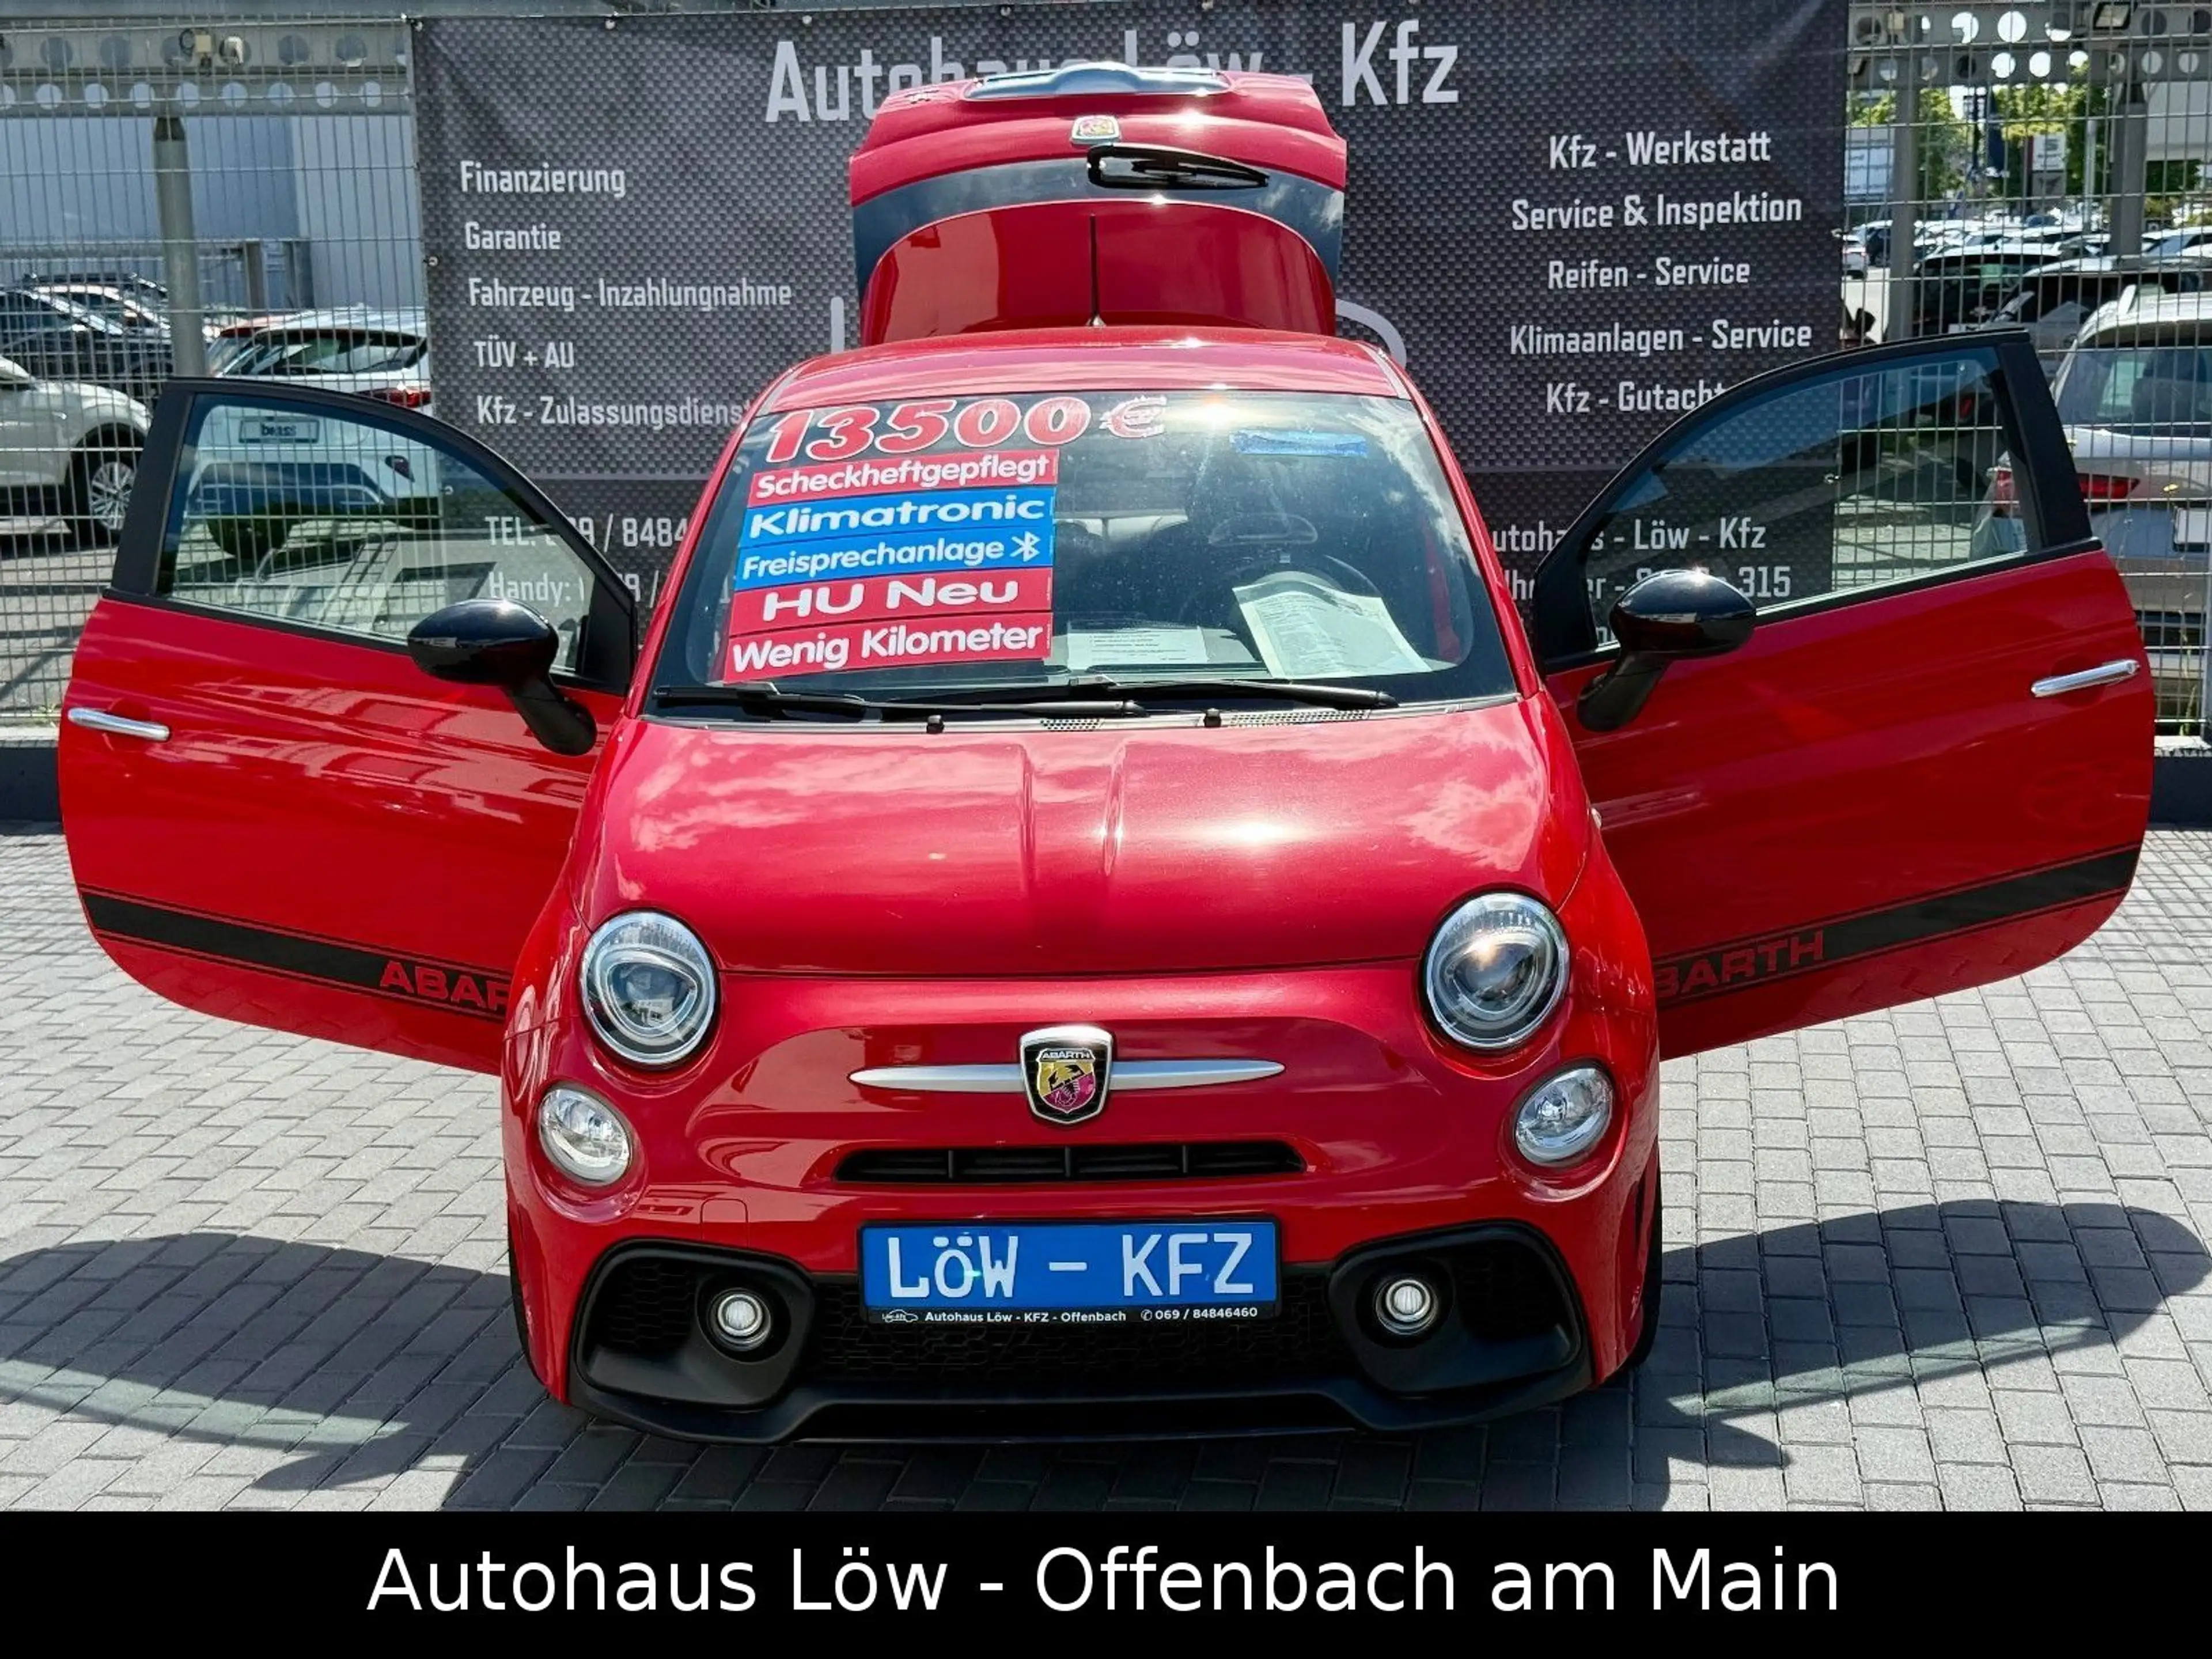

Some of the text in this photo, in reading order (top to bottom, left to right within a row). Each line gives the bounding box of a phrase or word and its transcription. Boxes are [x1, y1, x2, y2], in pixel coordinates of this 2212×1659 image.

[1343, 20, 1458, 106] Kfz
[1550, 134, 1596, 169] Kfz
[1626, 130, 1771, 165] Werkstatt
[460, 160, 626, 198] Finanzierung
[1512, 191, 1801, 230] Service & Inspektion
[464, 221, 561, 250] Garantie
[1548, 259, 1628, 289] Reifen
[1656, 256, 1750, 286] Service
[468, 277, 575, 312] Fahrzeug
[599, 277, 792, 312] Inzahlungnahme
[473, 334, 575, 369] TÜV + AU
[1510, 321, 1683, 357] Klimaanlagen
[1712, 319, 1812, 349] Service
[477, 395, 517, 424] Kfz
[540, 396, 750, 430] Zulassungsdiens
[1547, 382, 1590, 413] Kfz
[756, 454, 1050, 498] Scheckheftgepflegt
[749, 495, 1046, 539] Klimatronic
[1635, 520, 1690, 550] Löw
[1720, 517, 1766, 548] Kfz
[743, 539, 1005, 579] Freisprechanlage
[488, 571, 571, 607] Handy:
[762, 584, 865, 622] HU
[886, 578, 1020, 609] Neu
[1738, 566, 1790, 597] 315
[732, 632, 850, 673] Wenig
[861, 622, 1044, 658] Kilometer
[1655, 930, 1824, 998] BARTH
[1043, 1051, 1090, 1059] ABARTH
[1049, 1262, 1086, 1271] -
[1123, 1233, 1253, 1296] KFZ
[924, 1312, 983, 1323] Autohaus
[987, 1311, 1013, 1323] Löw
[1024, 1312, 1050, 1323] KFZ
[1060, 1310, 1126, 1322] Offenbach
[1155, 1306, 1257, 1320] 069 / 84846460
